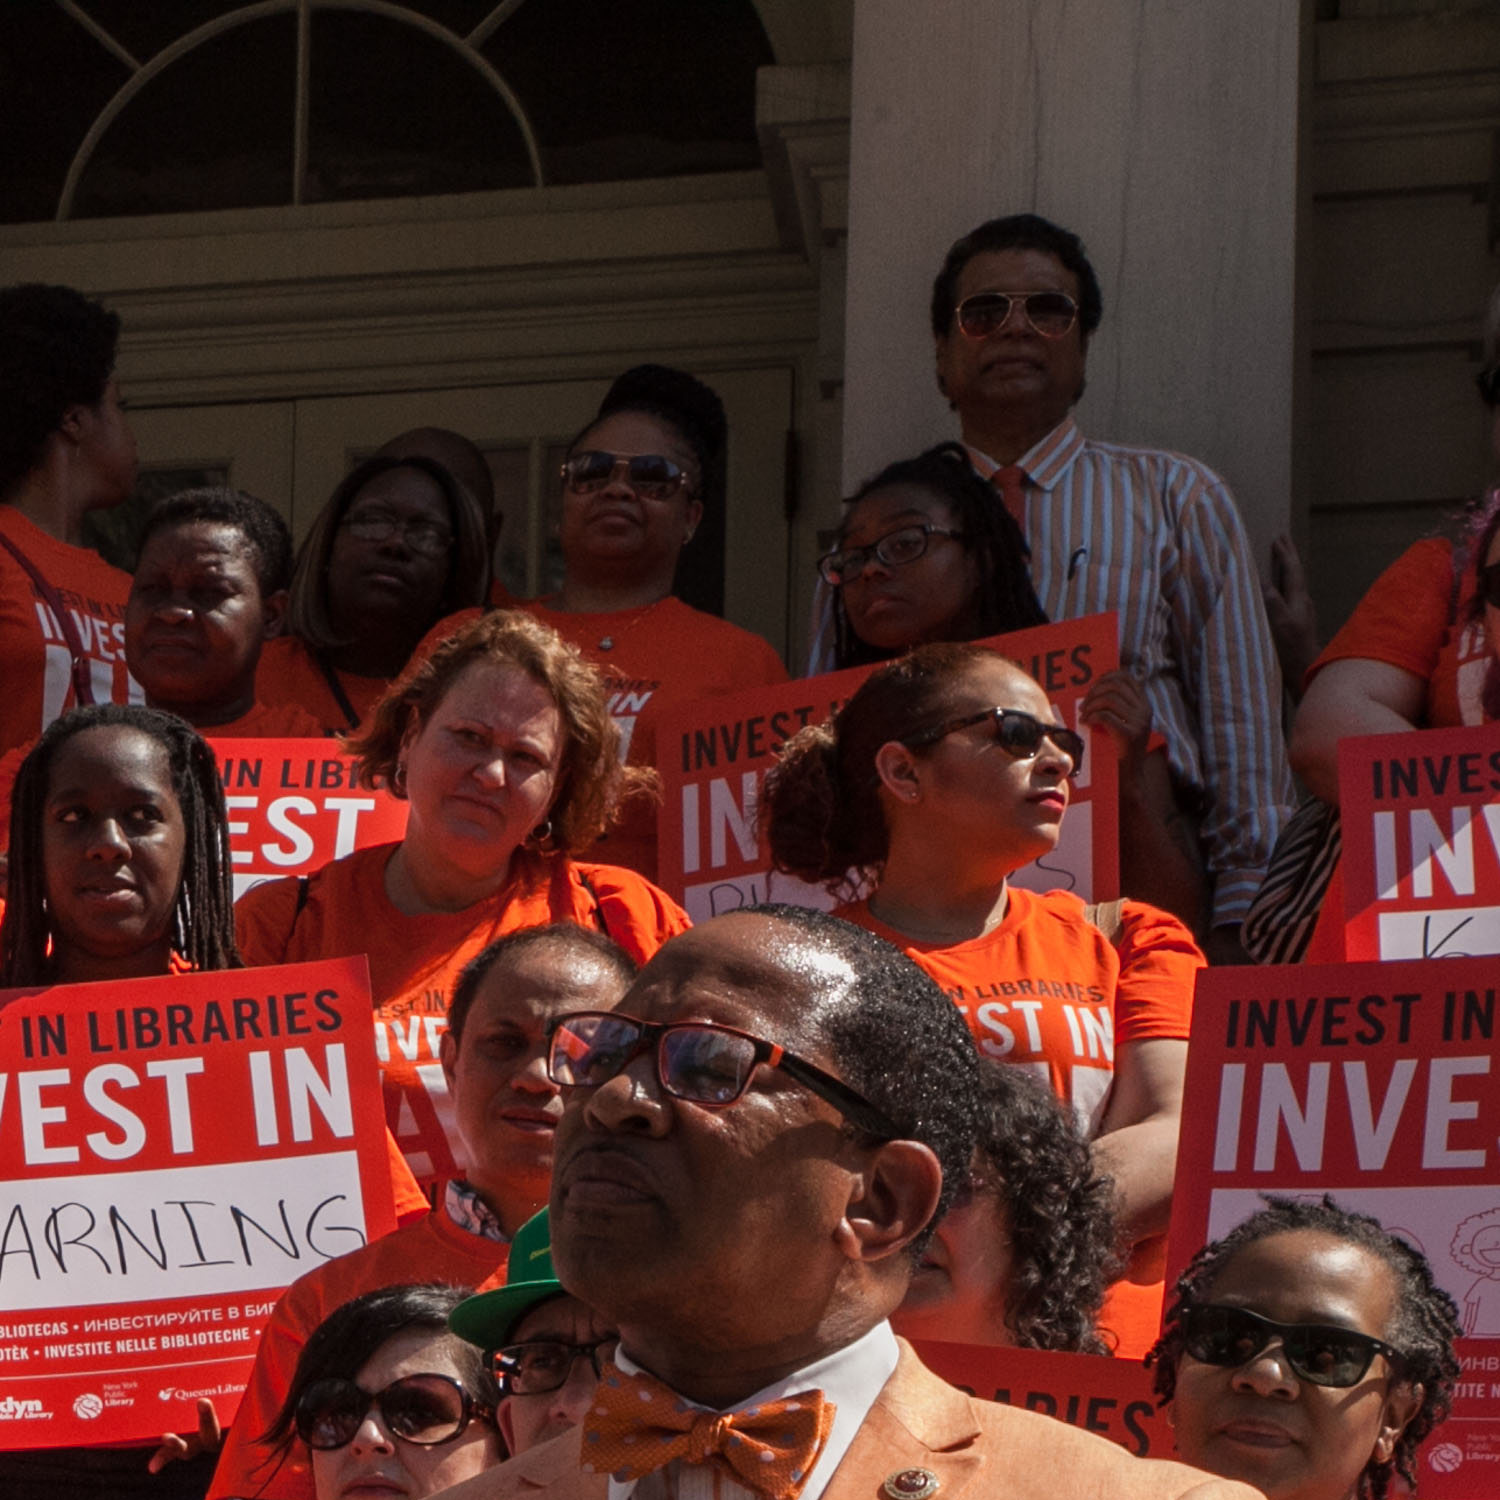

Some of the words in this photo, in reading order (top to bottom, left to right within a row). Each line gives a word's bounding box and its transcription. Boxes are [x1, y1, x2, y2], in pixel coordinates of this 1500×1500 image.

[224, 759, 262, 787] IN
[425, 989, 446, 1012] IN
[975, 978, 1106, 1004] LIBRARIES
[21, 1012, 68, 1058] IN
[89, 988, 344, 1053] LIBRARIES
[959, 1000, 1043, 1058] ST
[1062, 1005, 1115, 1062] IN
[1226, 994, 1422, 1048] INVEST
[1442, 989, 1496, 1042] IN
[248, 1043, 355, 1147] IN
[1213, 1055, 1500, 1173] INVE
[84, 1307, 222, 1333] ИНВЕСТИРУЙТЕ
[45, 1340, 111, 1359] INVESTITE
[117, 1337, 157, 1352] NELLE
[162, 1328, 250, 1349] BIBLIOTECHE
[105, 1397, 134, 1407] Library
[175, 1386, 217, 1400] Queens
